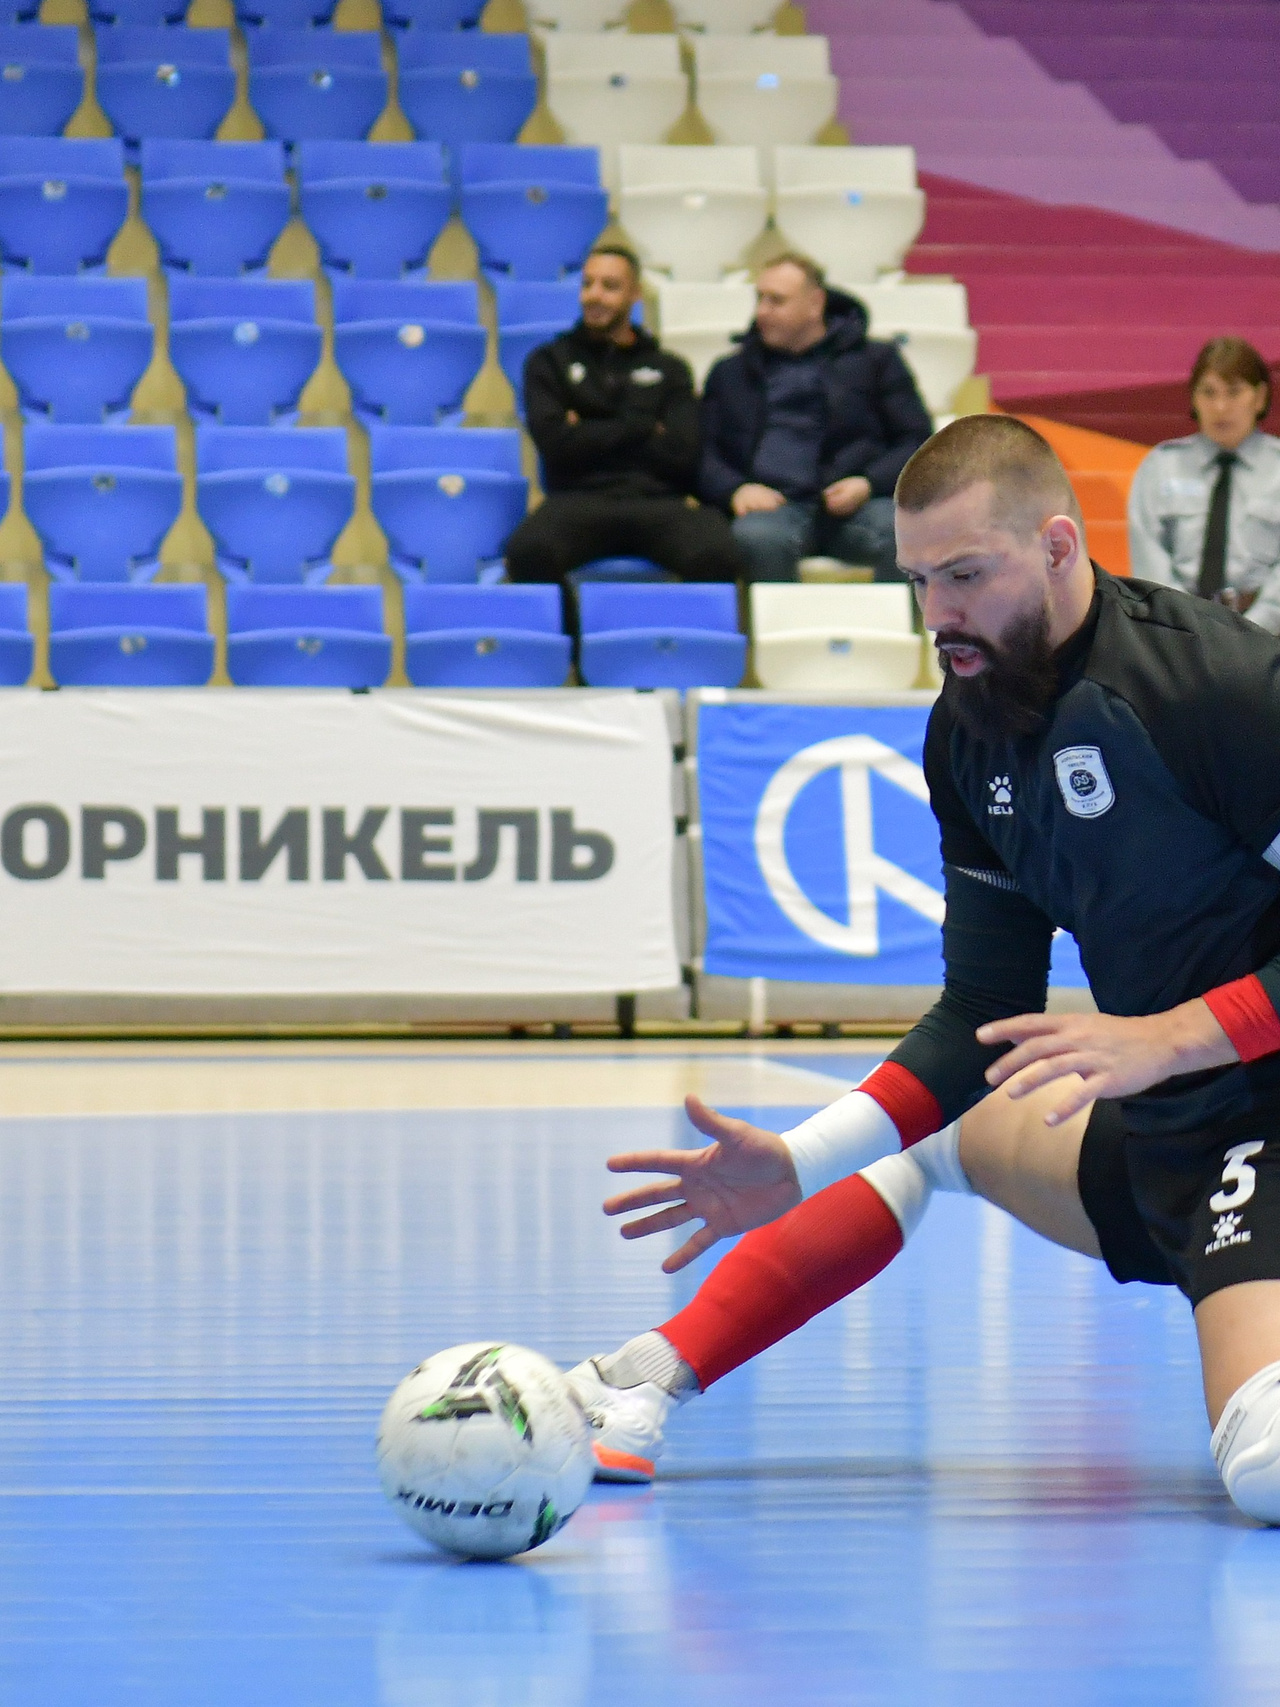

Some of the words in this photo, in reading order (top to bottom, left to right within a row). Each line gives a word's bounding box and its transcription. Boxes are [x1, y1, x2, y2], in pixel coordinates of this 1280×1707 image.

[2, 802, 616, 883] ОРНИКЕЛЬ
[1204, 1230, 1252, 1256] KELME
[394, 1486, 514, 1518] DEMIX
